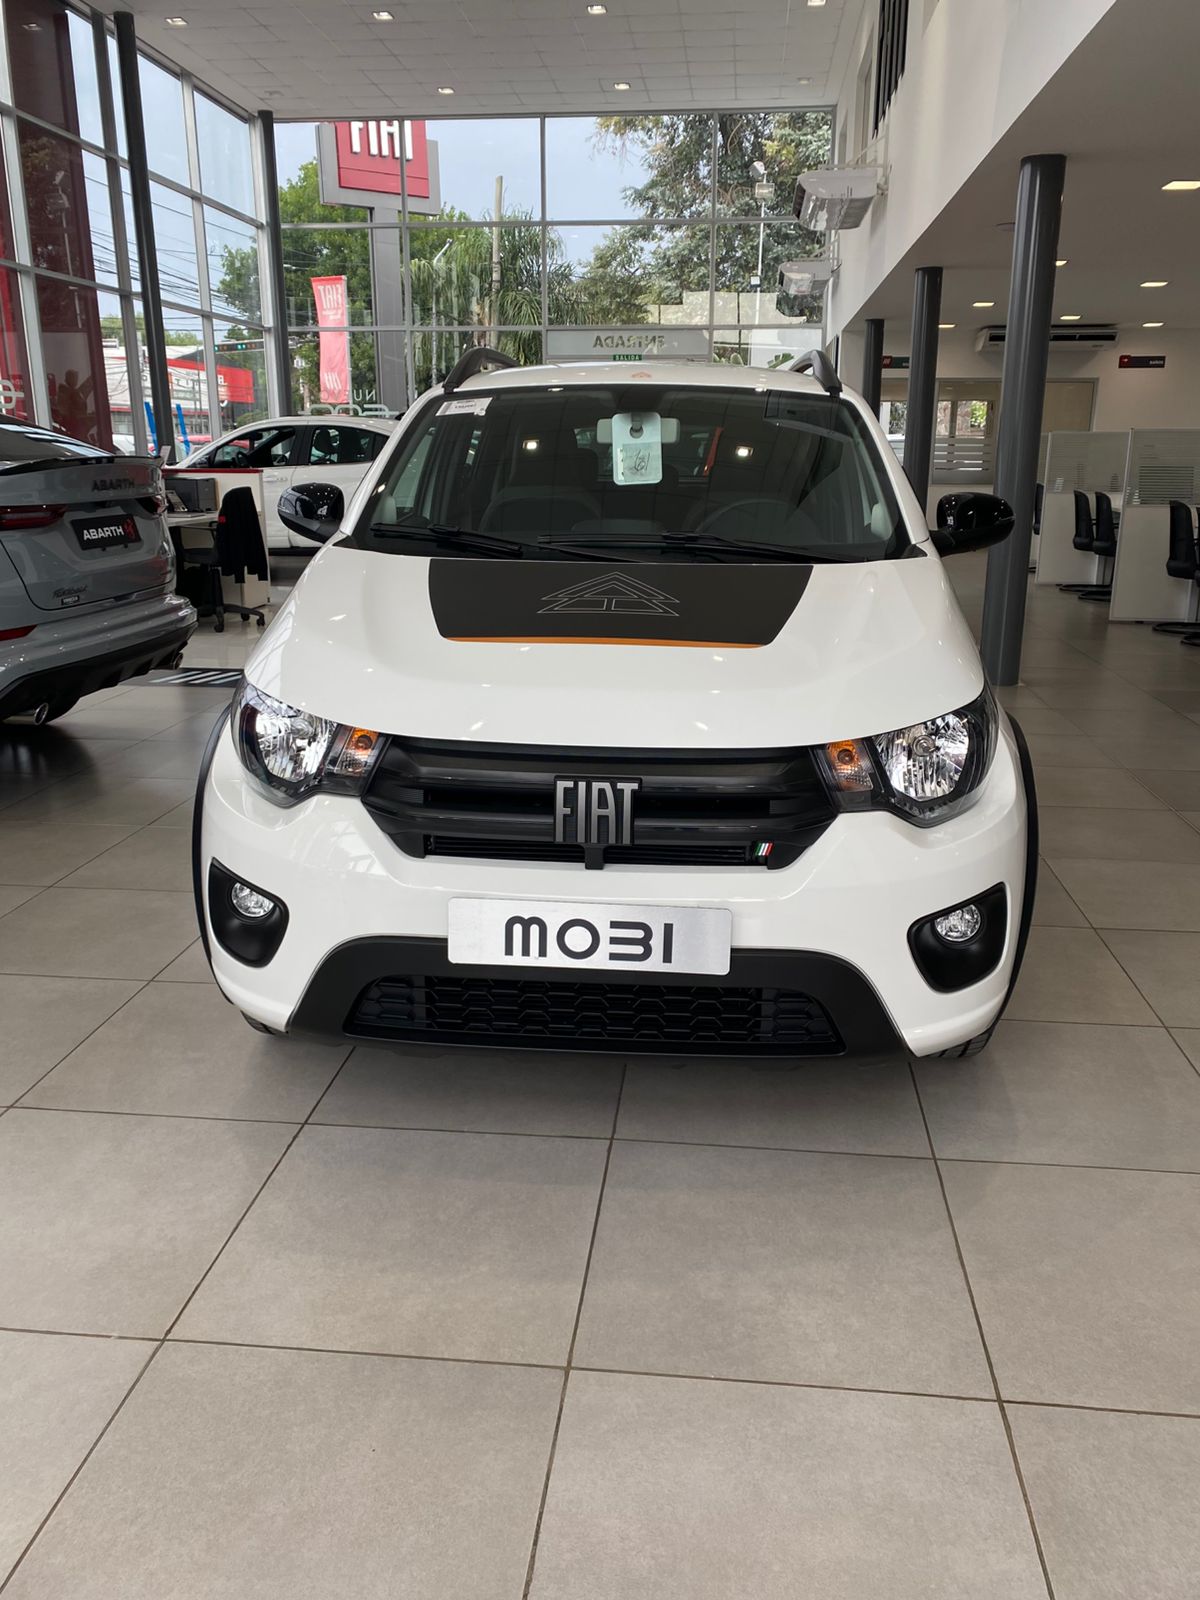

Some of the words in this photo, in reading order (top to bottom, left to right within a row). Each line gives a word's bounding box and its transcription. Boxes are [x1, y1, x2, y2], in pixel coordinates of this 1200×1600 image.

[92, 479, 135, 492] ABARTH
[83, 525, 124, 541] ABARTH
[555, 780, 639, 845] FIAT
